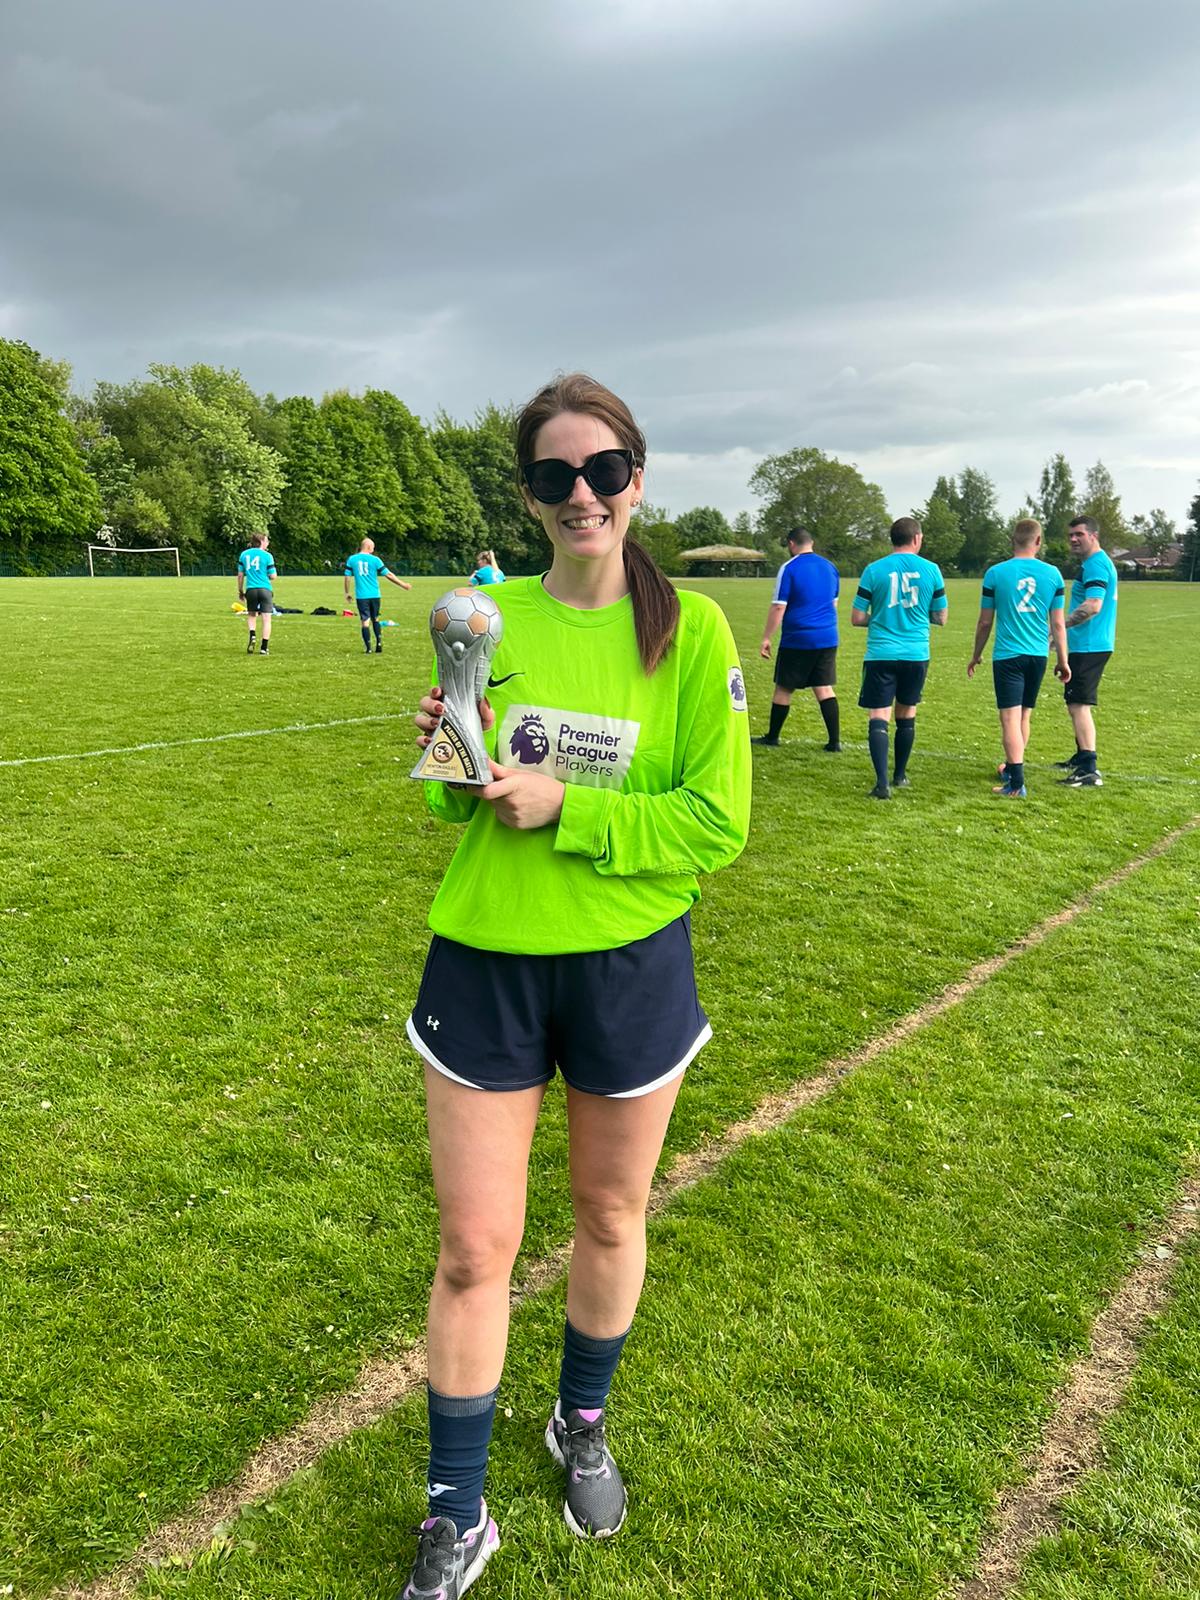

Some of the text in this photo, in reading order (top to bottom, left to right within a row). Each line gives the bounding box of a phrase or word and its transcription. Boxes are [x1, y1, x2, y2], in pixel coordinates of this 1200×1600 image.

[245, 555, 260, 571] 14
[888, 571, 921, 609] 15
[1016, 576, 1037, 613] 2
[559, 723, 621, 747] Premier
[557, 739, 618, 762] League
[555, 755, 613, 777] Players
